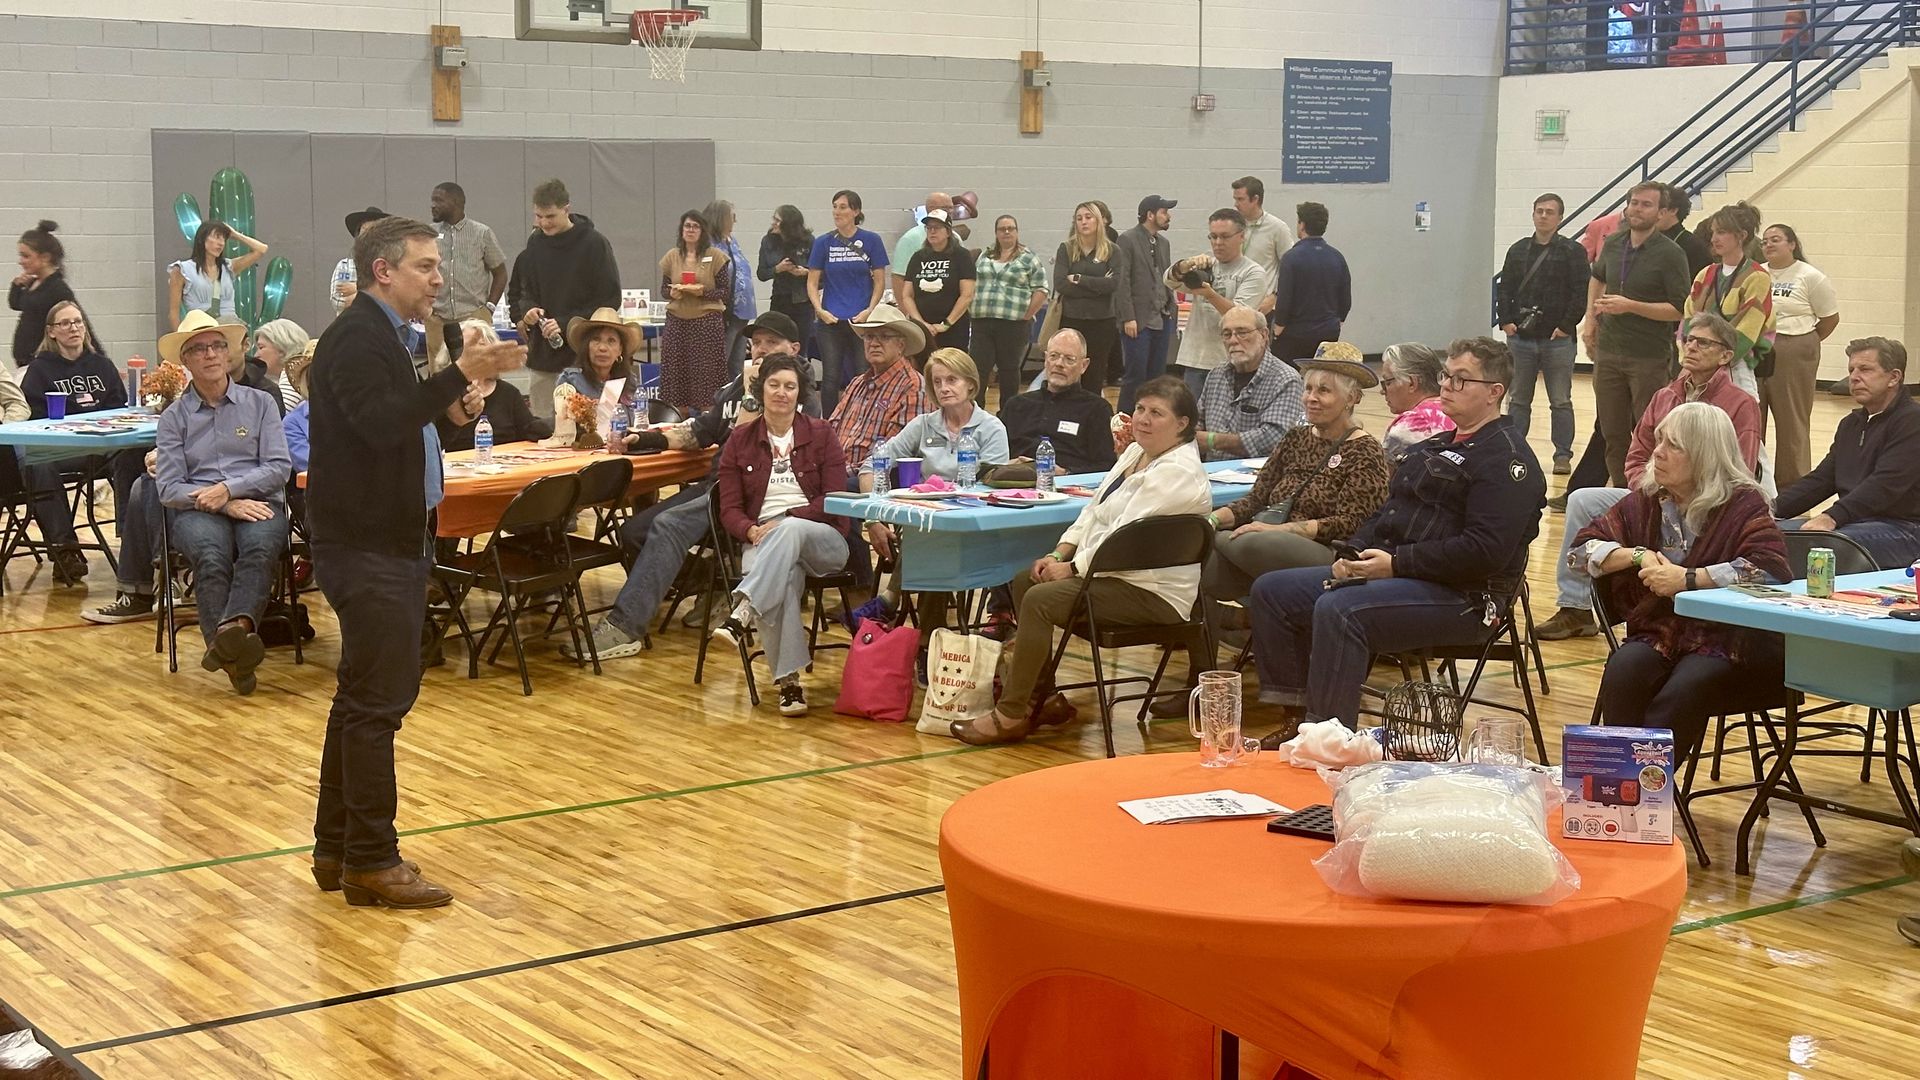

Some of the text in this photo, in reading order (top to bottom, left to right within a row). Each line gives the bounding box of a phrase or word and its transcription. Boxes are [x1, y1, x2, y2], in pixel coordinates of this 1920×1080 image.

[921, 260, 950, 269] VOTE
[54, 375, 106, 396] USA
[941, 676, 976, 690] BELONGS
[958, 704, 968, 712] US
